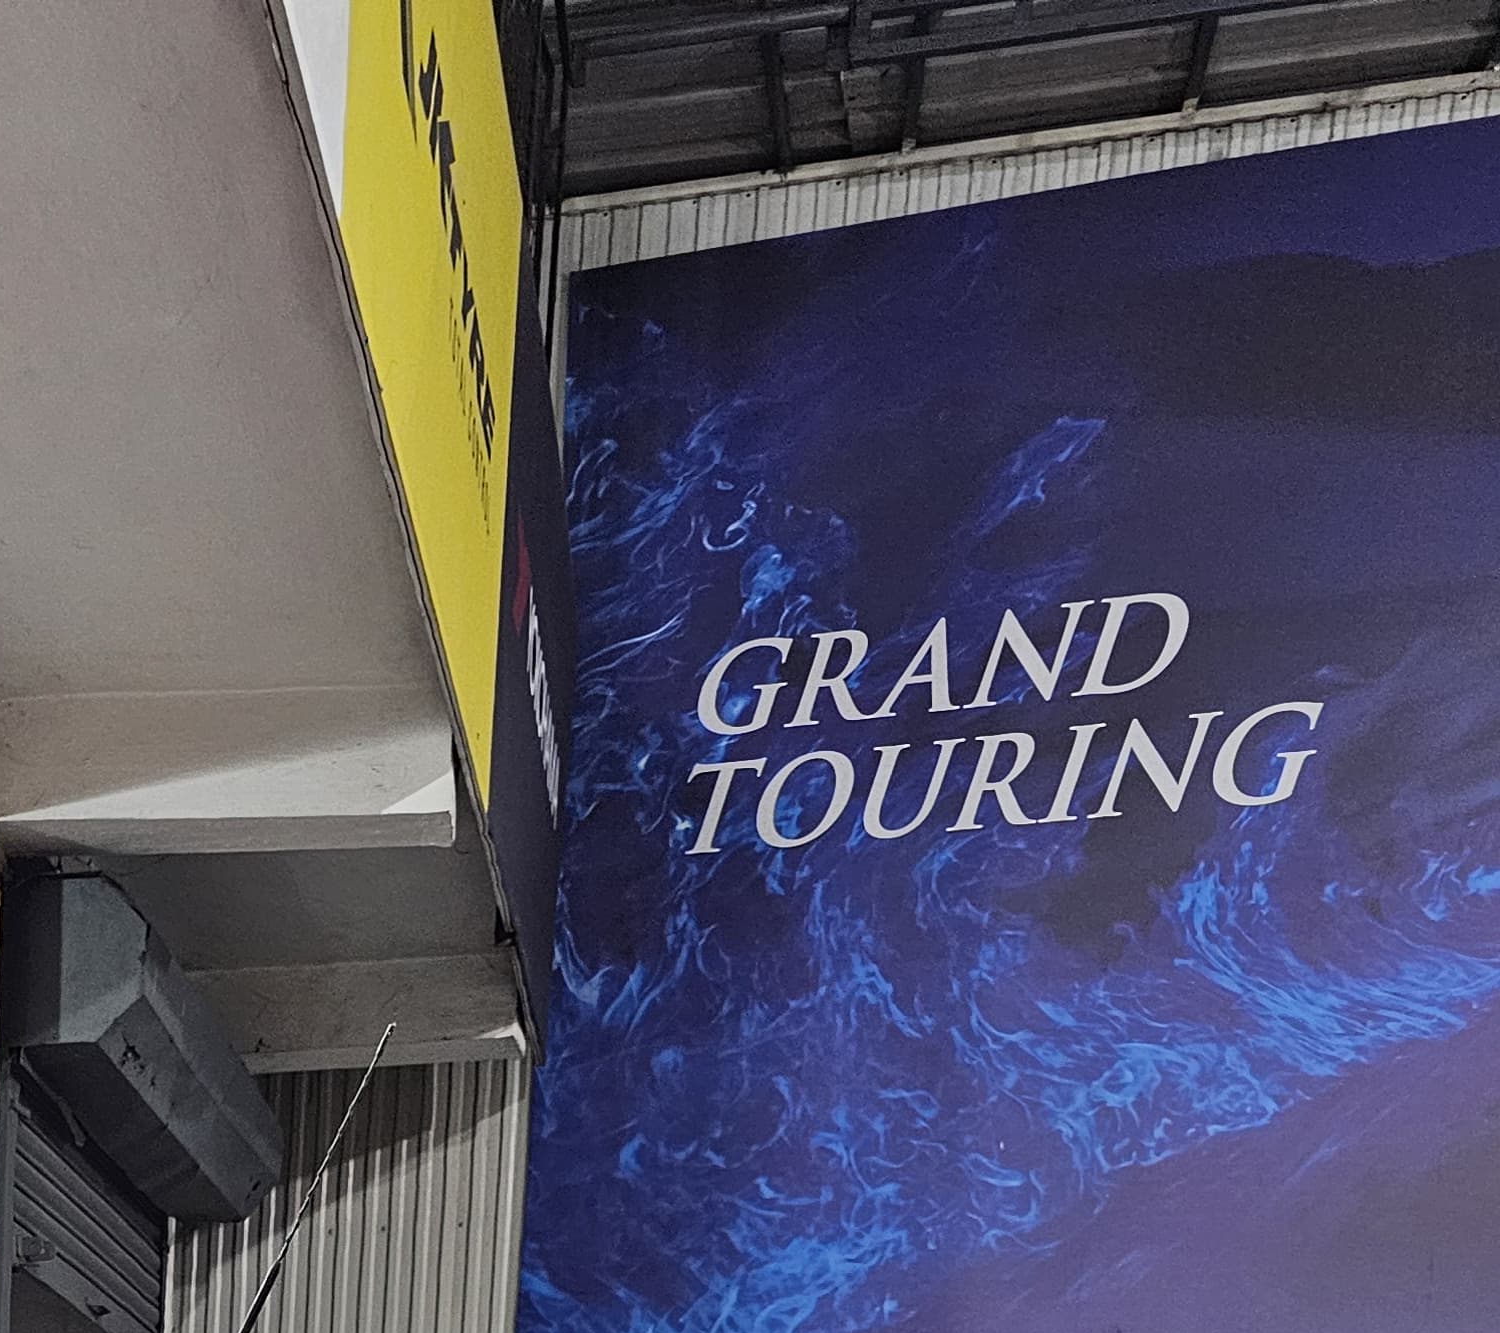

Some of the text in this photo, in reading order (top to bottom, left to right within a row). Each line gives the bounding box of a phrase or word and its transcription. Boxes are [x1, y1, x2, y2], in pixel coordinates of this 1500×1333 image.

[449, 186, 496, 462] TYRE
[698, 592, 1190, 736] GRAND
[684, 701, 1324, 855] TOURING
